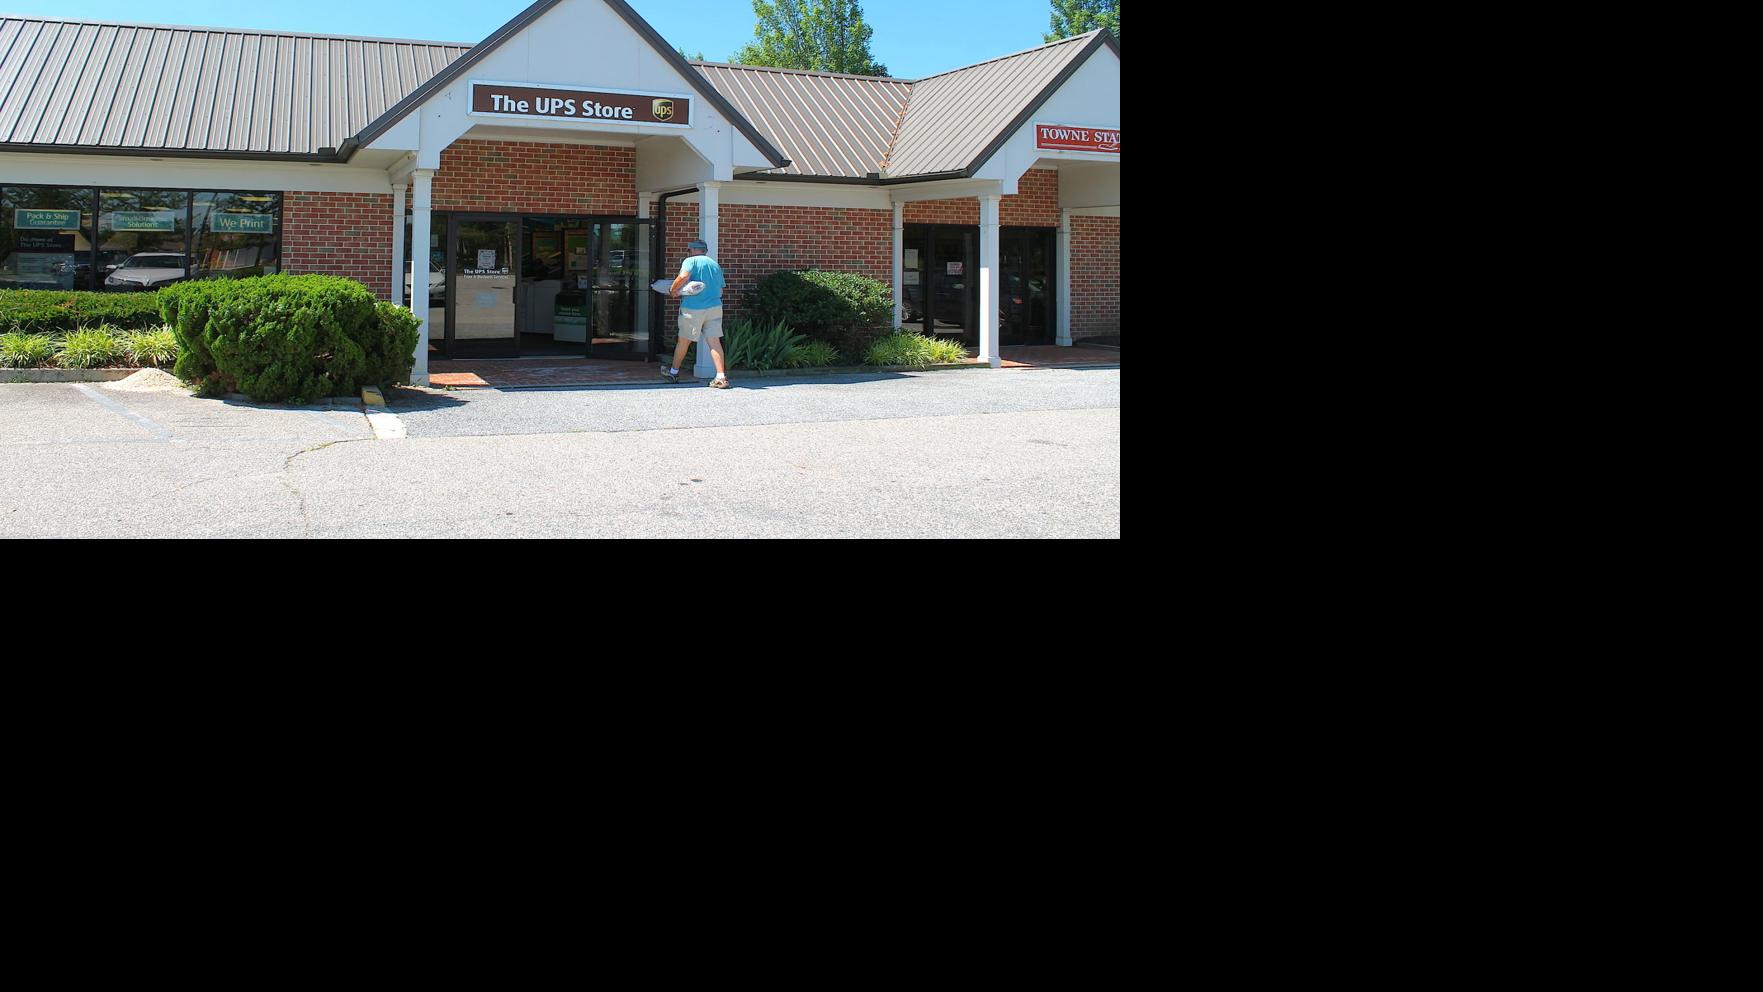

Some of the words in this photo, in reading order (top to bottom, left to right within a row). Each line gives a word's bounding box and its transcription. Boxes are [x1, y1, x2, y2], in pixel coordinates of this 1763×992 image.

[490, 94, 529, 113] The
[535, 97, 577, 116] UPS
[582, 100, 633, 119] Store
[655, 105, 673, 118] ups
[1041, 128, 1090, 142] TOWNE
[26, 212, 44, 220] Pack
[54, 213, 69, 221] Ship
[220, 217, 237, 228] We
[240, 218, 264, 228] Print
